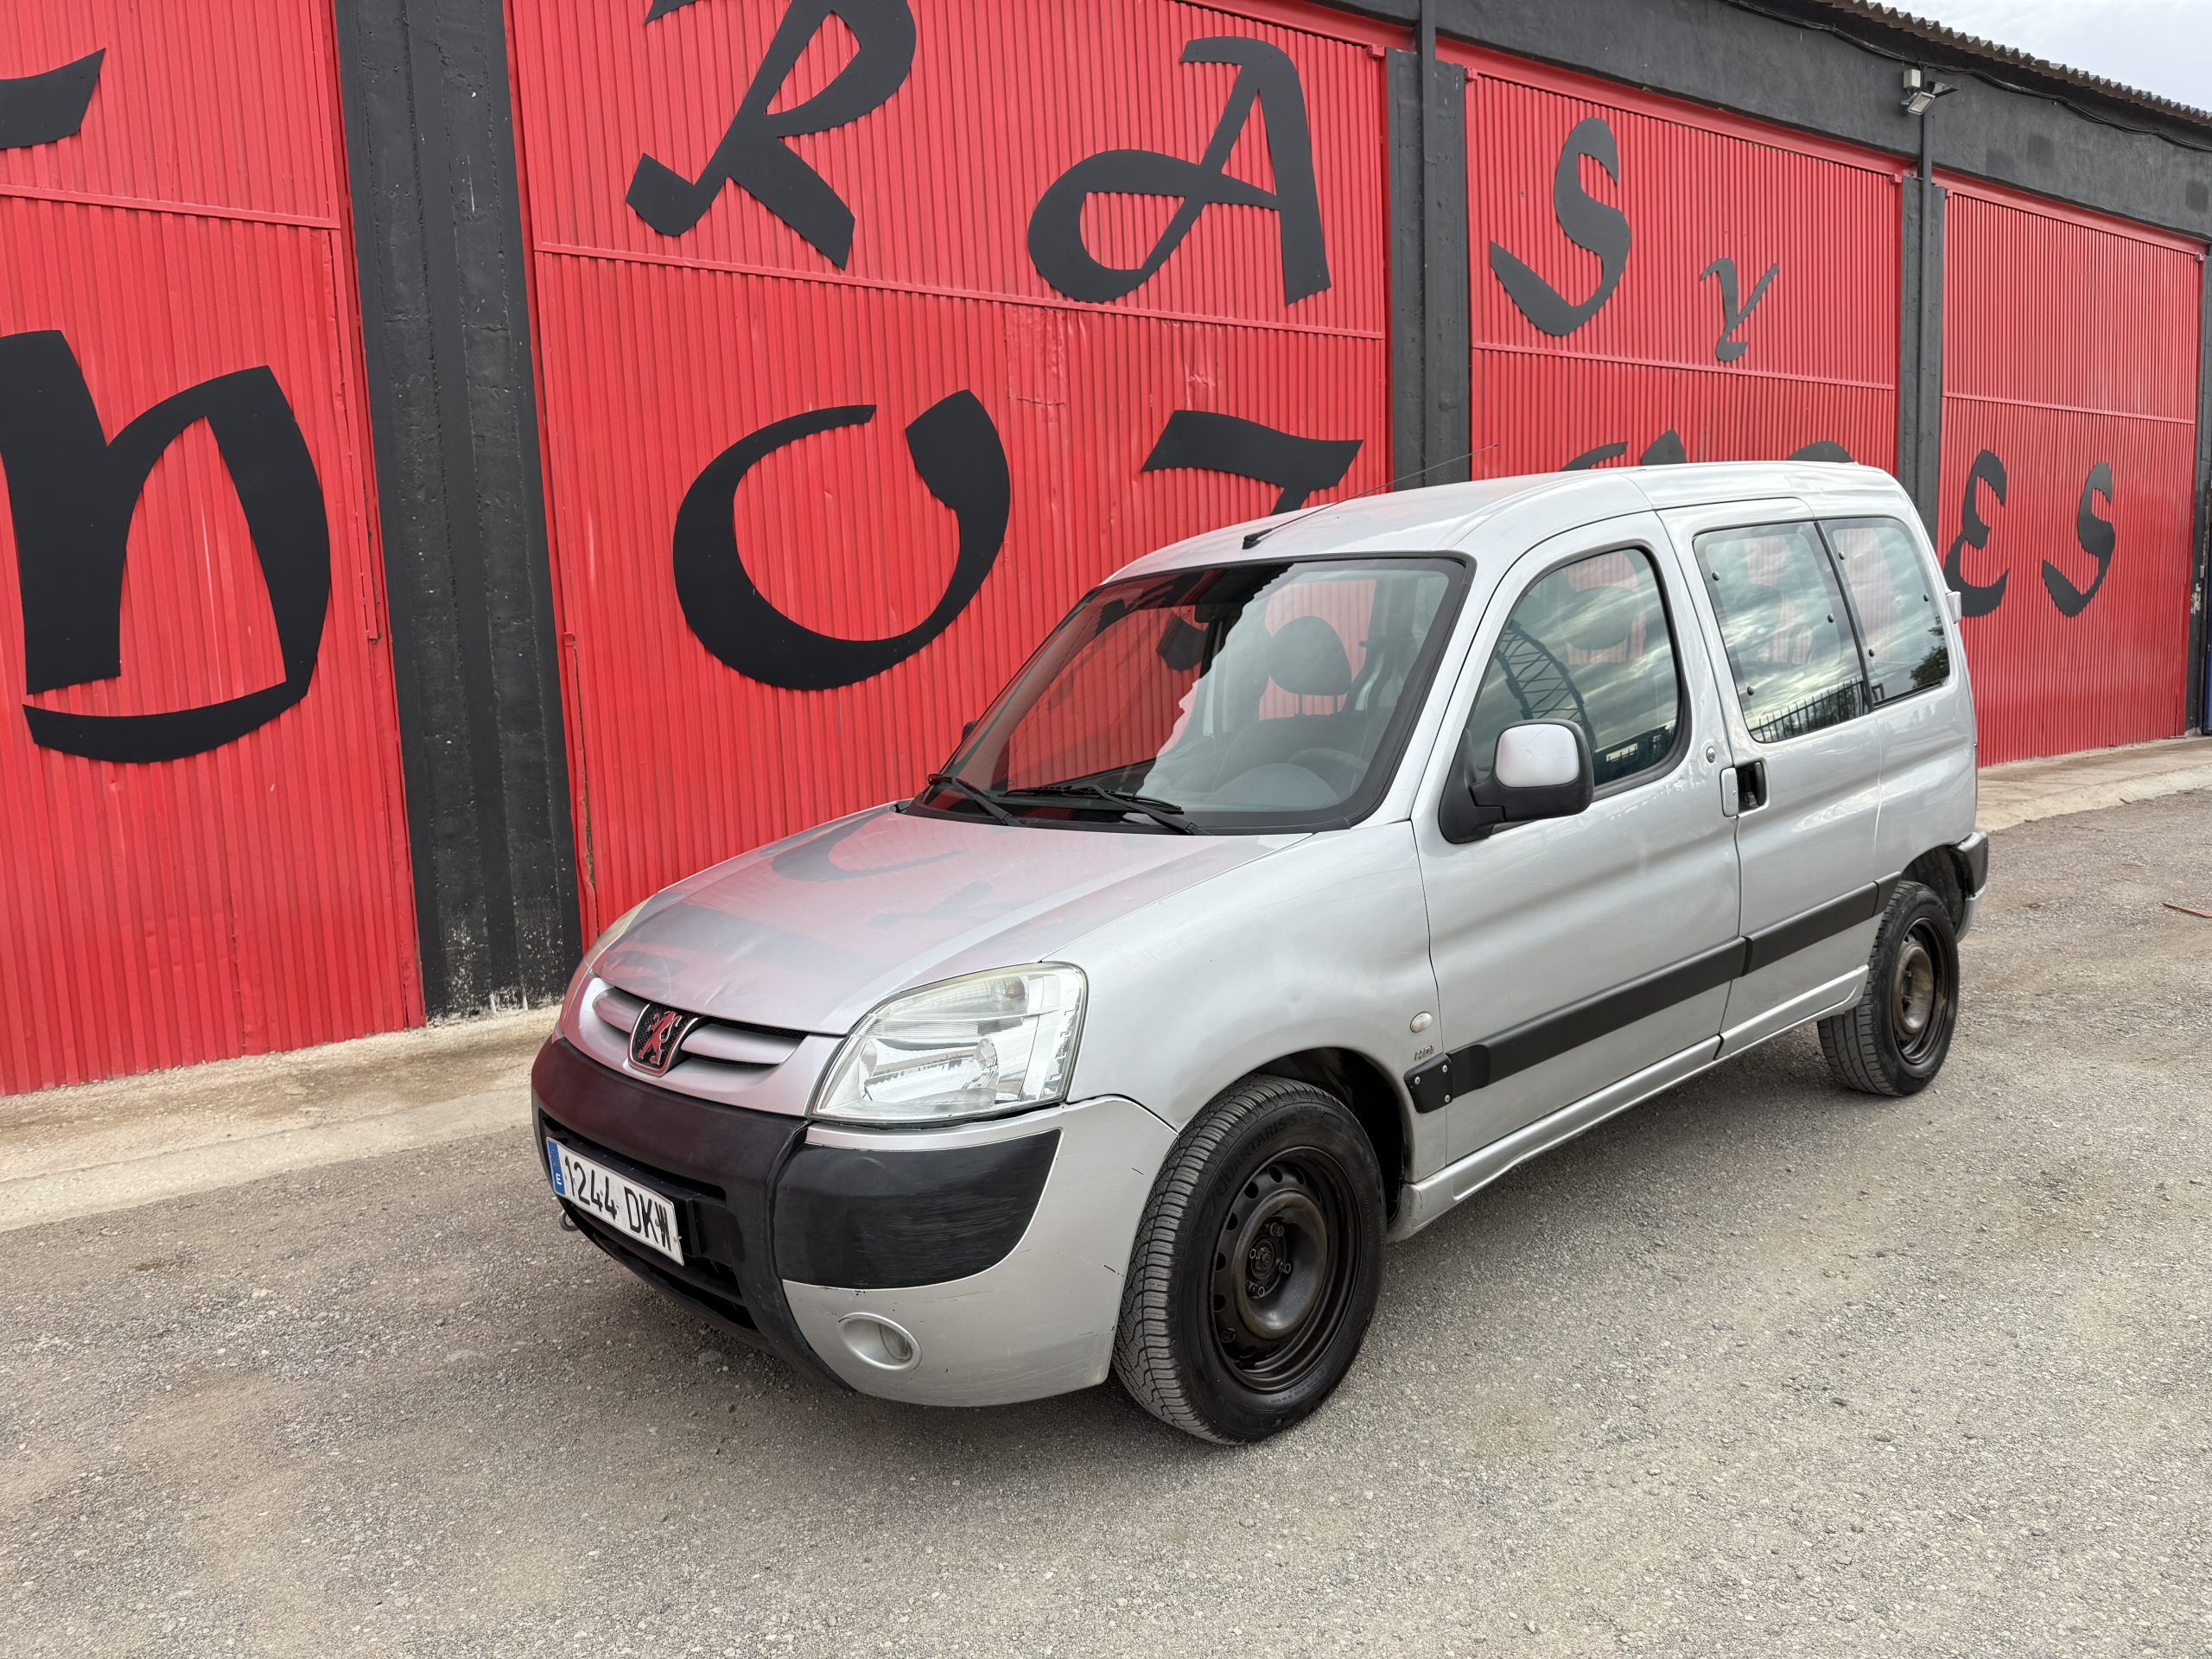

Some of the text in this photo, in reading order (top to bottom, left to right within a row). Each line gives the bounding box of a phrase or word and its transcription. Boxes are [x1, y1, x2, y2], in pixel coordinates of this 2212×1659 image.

[556, 1173, 563, 1185] E
[564, 1154, 672, 1252] 1244 DKW
